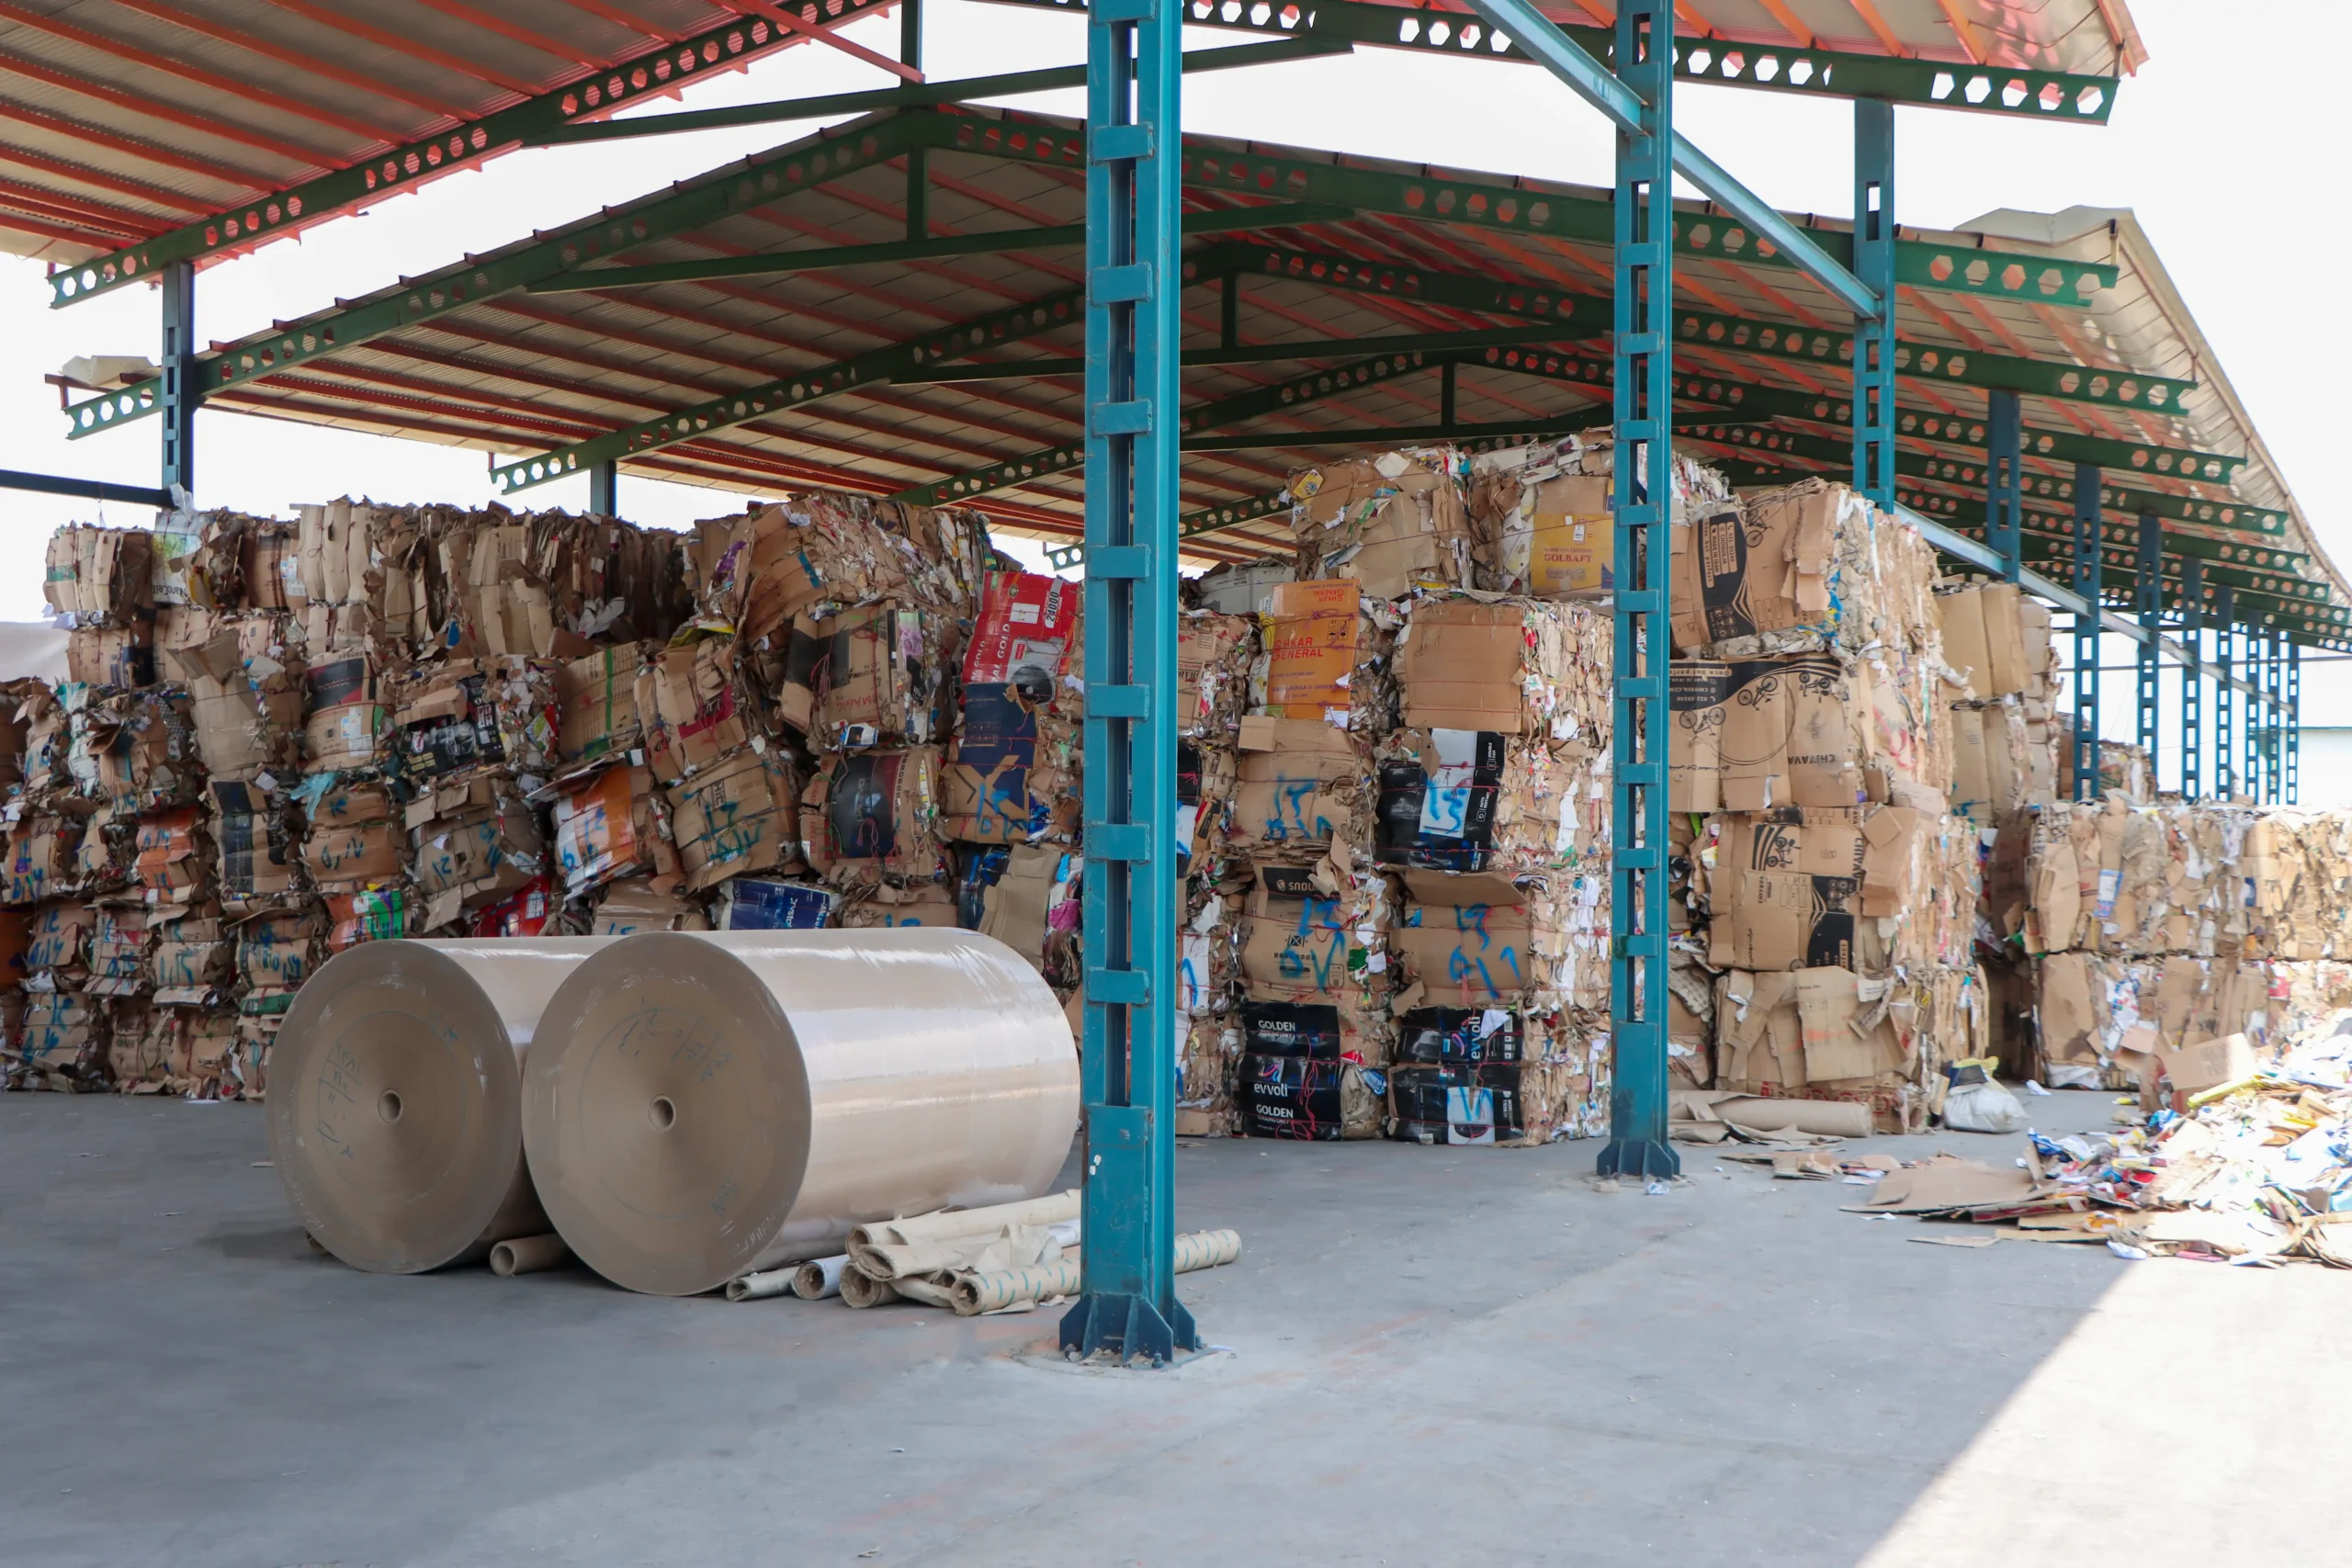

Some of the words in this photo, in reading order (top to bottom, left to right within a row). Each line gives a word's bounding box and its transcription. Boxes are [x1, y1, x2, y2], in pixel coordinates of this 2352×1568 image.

[1544, 553, 1592, 563] GOLBAFT
[1313, 589, 1344, 597] GENERAL
[1046, 591, 1059, 623] 24000
[997, 623, 1011, 660] GOLD
[1274, 637, 1314, 652] SHKAR
[1272, 649, 1324, 662] GENERAL
[1258, 1020, 1296, 1032] GOLDEN
[1253, 1082, 1289, 1098] evvoli
[1256, 1103, 1295, 1119] GOLDEN
